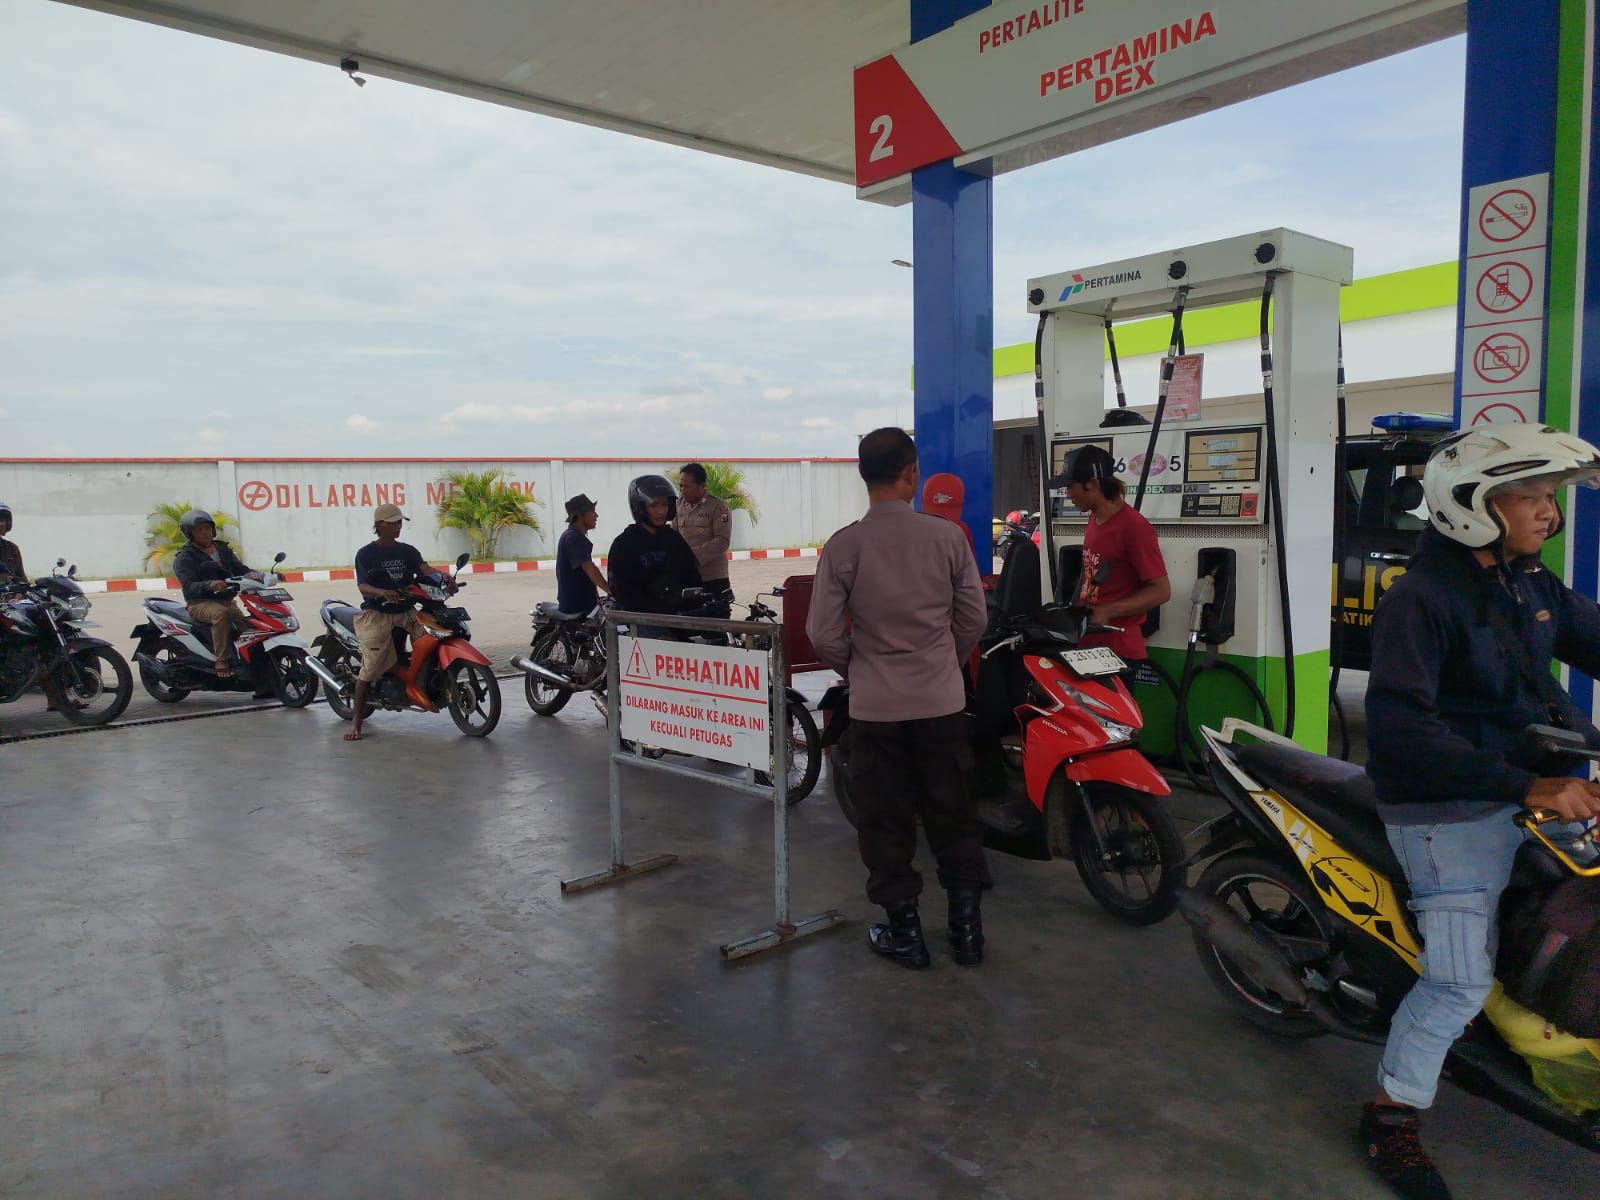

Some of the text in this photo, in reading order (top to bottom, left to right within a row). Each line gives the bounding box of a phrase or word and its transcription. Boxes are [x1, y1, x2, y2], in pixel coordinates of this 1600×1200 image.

[979, 0, 1084, 54] PERTALITE
[1040, 12, 1217, 97] PERTAMINA
[1094, 61, 1155, 104] DEX
[869, 114, 893, 164] 2
[1084, 270, 1141, 290] PERTAMINA
[1169, 455, 1181, 472] 5
[275, 483, 406, 508] DILARANG
[655, 654, 760, 690] PERHATIAN
[626, 694, 764, 731] DILARANG MASUK KE AREA INI
[1042, 719, 1068, 736] HONDA
[650, 720, 733, 748] KECUALI PETUGAS
[1260, 796, 1280, 815] YAMAHA
